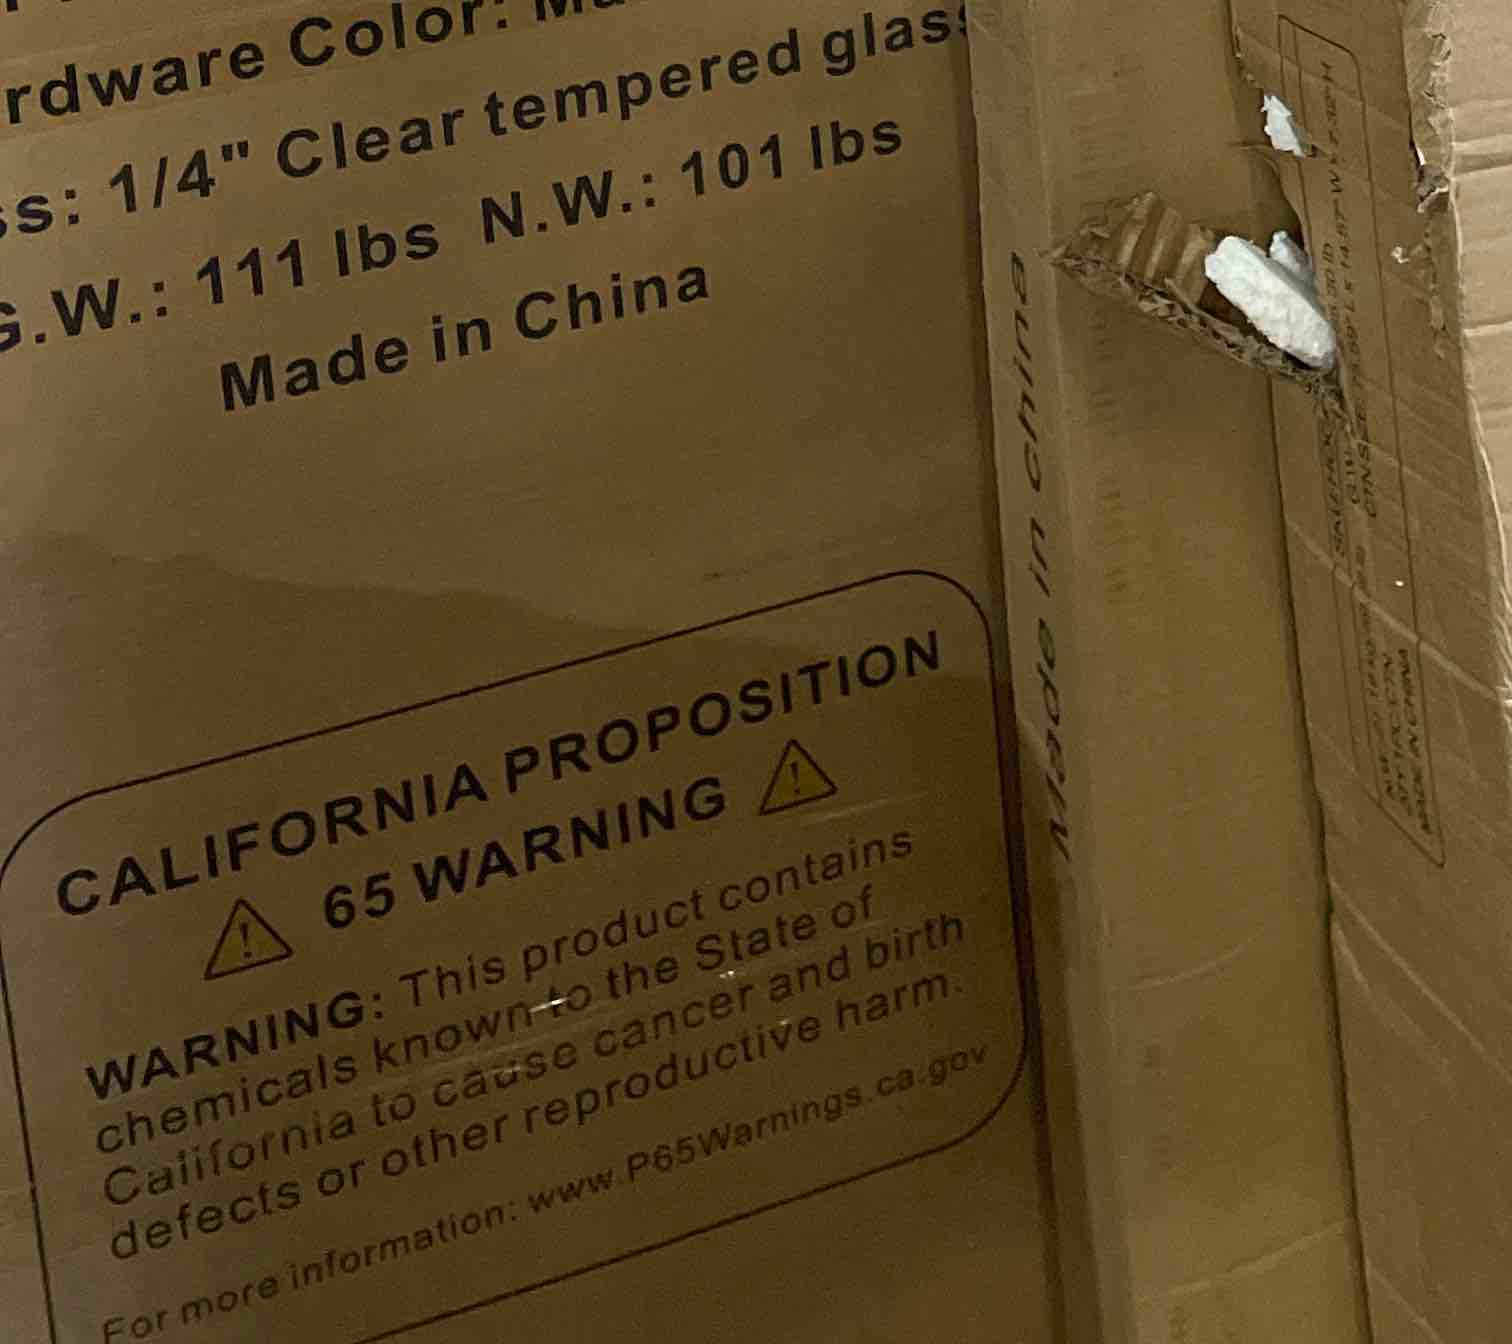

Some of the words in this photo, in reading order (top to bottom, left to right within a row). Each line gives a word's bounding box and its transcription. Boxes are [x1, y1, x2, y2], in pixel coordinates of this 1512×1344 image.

[0, 188, 81, 241] s:
[108, 140, 250, 213] 1/4"
[276, 107, 465, 180] Clear
[484, 27, 801, 138] tempered
[822, 2, 967, 77] glas
[5, 41, 266, 125] rdware
[195, 238, 305, 306] 111
[334, 220, 440, 279] lbs
[480, 168, 656, 244] N.W.:
[680, 133, 784, 197] 101
[809, 118, 903, 172] lbs
[219, 333, 409, 412] Made
[432, 313, 492, 363] in
[515, 263, 709, 341] China
[57, 761, 489, 918] CALIFORNIA
[503, 630, 941, 794] PROPOSITION
[323, 872, 396, 931] 65
[411, 776, 727, 905] WARNING
[85, 988, 385, 1103] WARNING:
[399, 952, 507, 1009] This
[521, 888, 705, 983] product
[718, 827, 915, 913] contains
[95, 1050, 360, 1156] chemicals
[373, 1000, 533, 1074] known
[543, 980, 593, 1025] to
[606, 947, 682, 1004] the
[695, 907, 818, 975] State
[832, 883, 876, 931] of
[103, 1114, 357, 1208] California
[372, 1087, 417, 1129] to
[432, 1040, 579, 1110] cause
[595, 986, 757, 1063] cancer
[768, 942, 852, 1002] and
[865, 909, 966, 969] birth
[103, 1308, 171, 1344] For
[179, 1274, 281, 1321] more
[287, 1200, 520, 1286] information:
[527, 1042, 989, 1217] www.P65Warnings.ca.gov
[111, 1177, 302, 1262] defects
[316, 1158, 367, 1198] or
[381, 1112, 508, 1179] other
[523, 1016, 823, 1134] reproductive
[836, 973, 966, 1033] harm.
